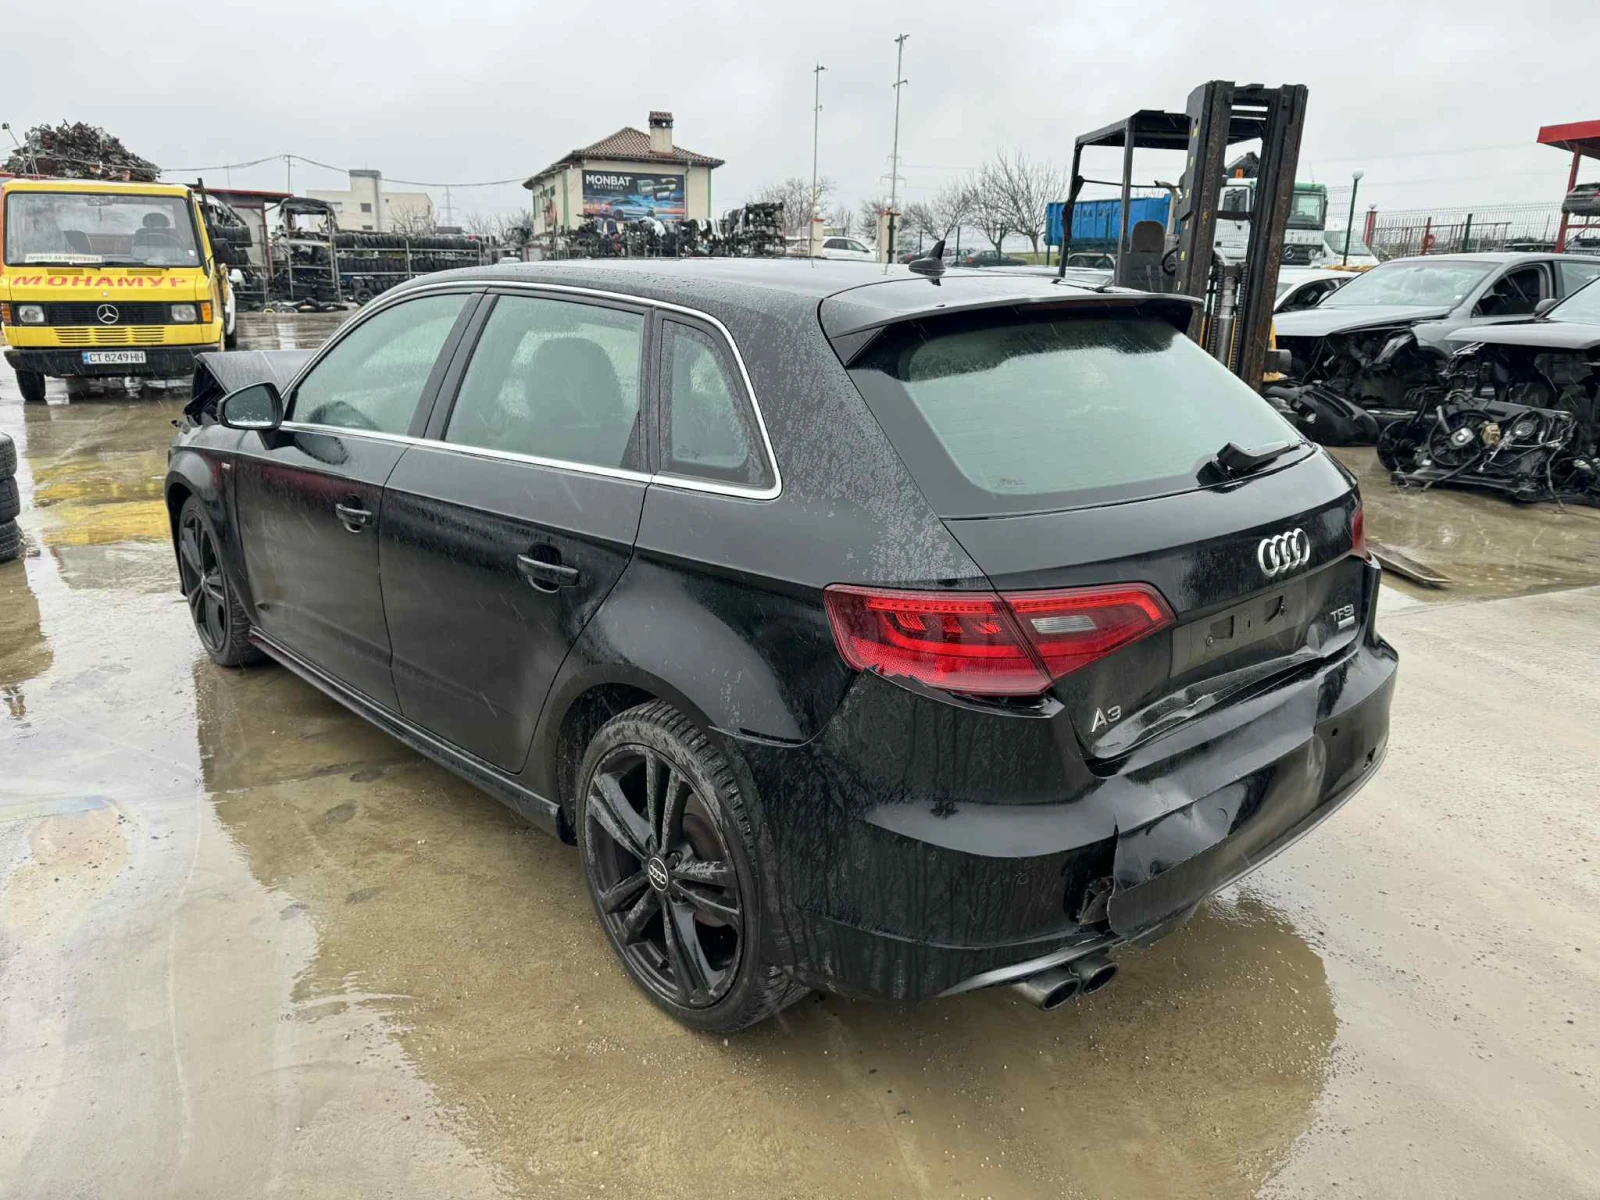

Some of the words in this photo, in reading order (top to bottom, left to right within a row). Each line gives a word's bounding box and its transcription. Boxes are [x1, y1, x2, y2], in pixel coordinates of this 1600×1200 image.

[585, 174, 631, 186] MONBAT
[12, 276, 187, 287] МОНАМУР
[104, 353, 129, 362] 8249
[1330, 604, 1354, 621] TFSI
[1091, 705, 1121, 732] A3
